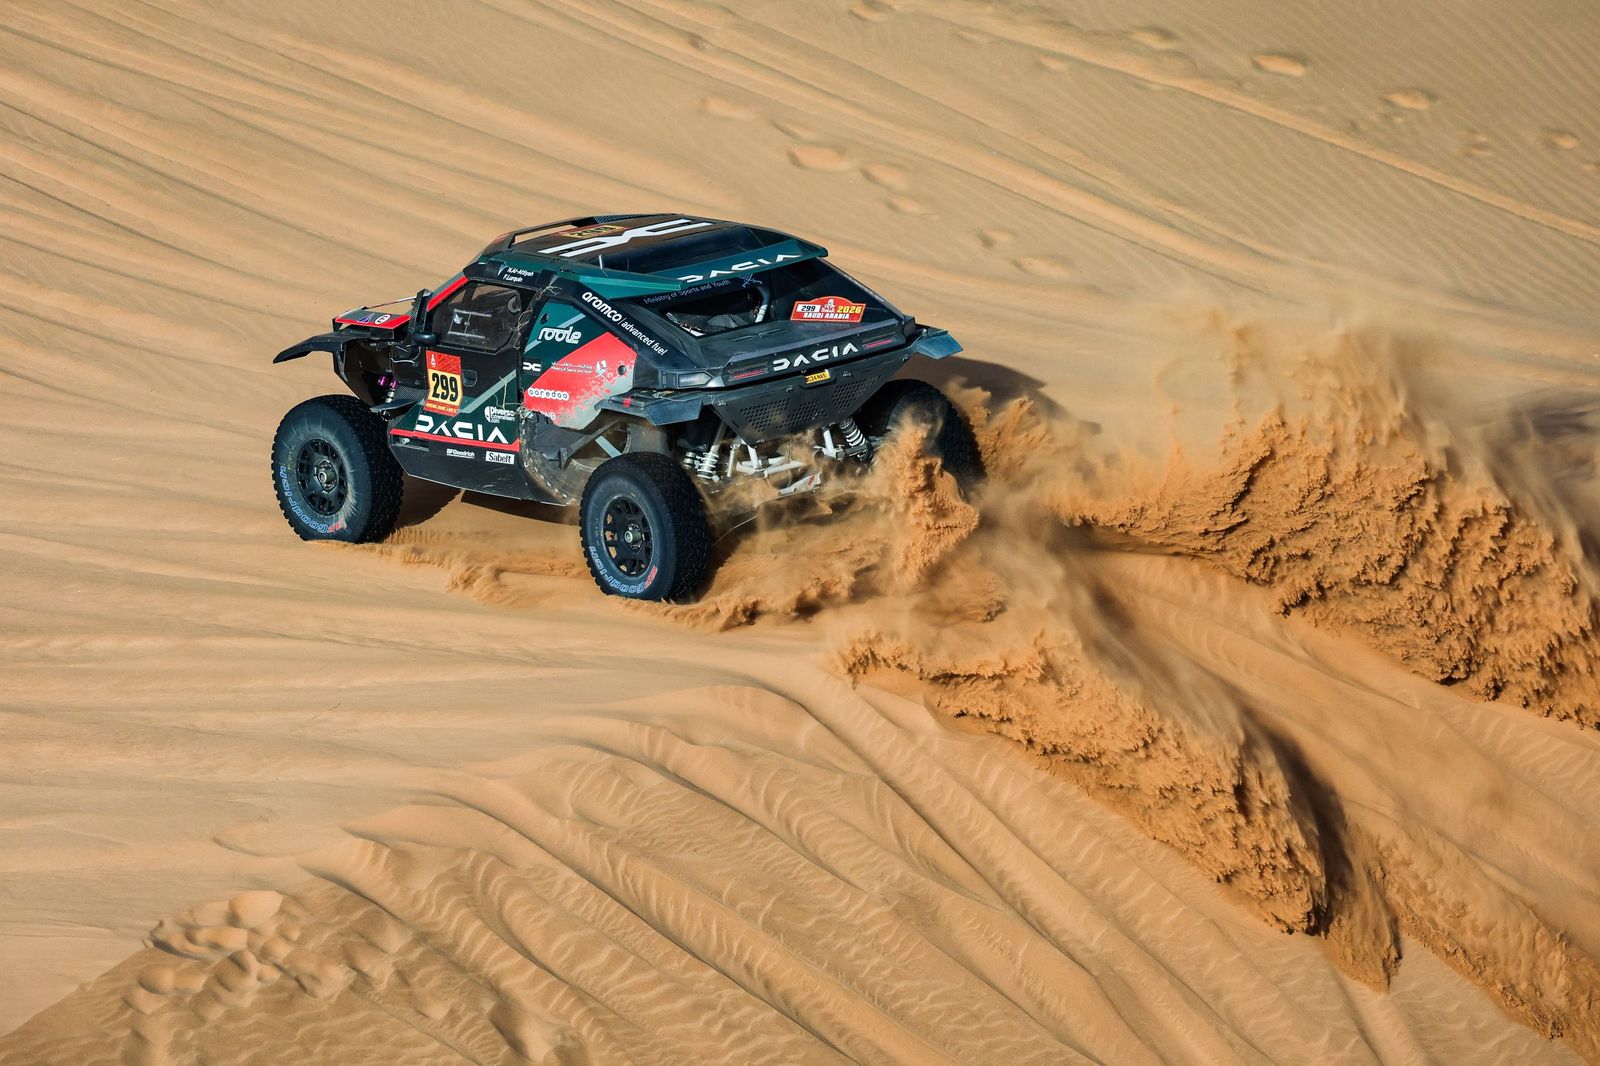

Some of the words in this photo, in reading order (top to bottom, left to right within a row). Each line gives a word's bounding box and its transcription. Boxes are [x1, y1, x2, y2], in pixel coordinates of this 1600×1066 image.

[677, 254, 802, 283] DACIA
[643, 293, 672, 305] Ministry
[670, 291, 678, 299] of
[678, 286, 700, 299] Sports
[700, 282, 712, 291] and
[712, 279, 731, 289] Youth
[582, 292, 622, 322] aramco
[836, 305, 862, 314] 2026
[621, 321, 655, 346] advanced
[651, 342, 668, 356] fuel
[772, 342, 859, 372] DACIA
[431, 372, 459, 403] 299
[528, 388, 569, 401] ooredoo
[490, 406, 515, 417] Diverse
[415, 414, 509, 445] DACIA
[446, 448, 475, 459] BFGoodrich
[488, 452, 511, 464] Sabelt
